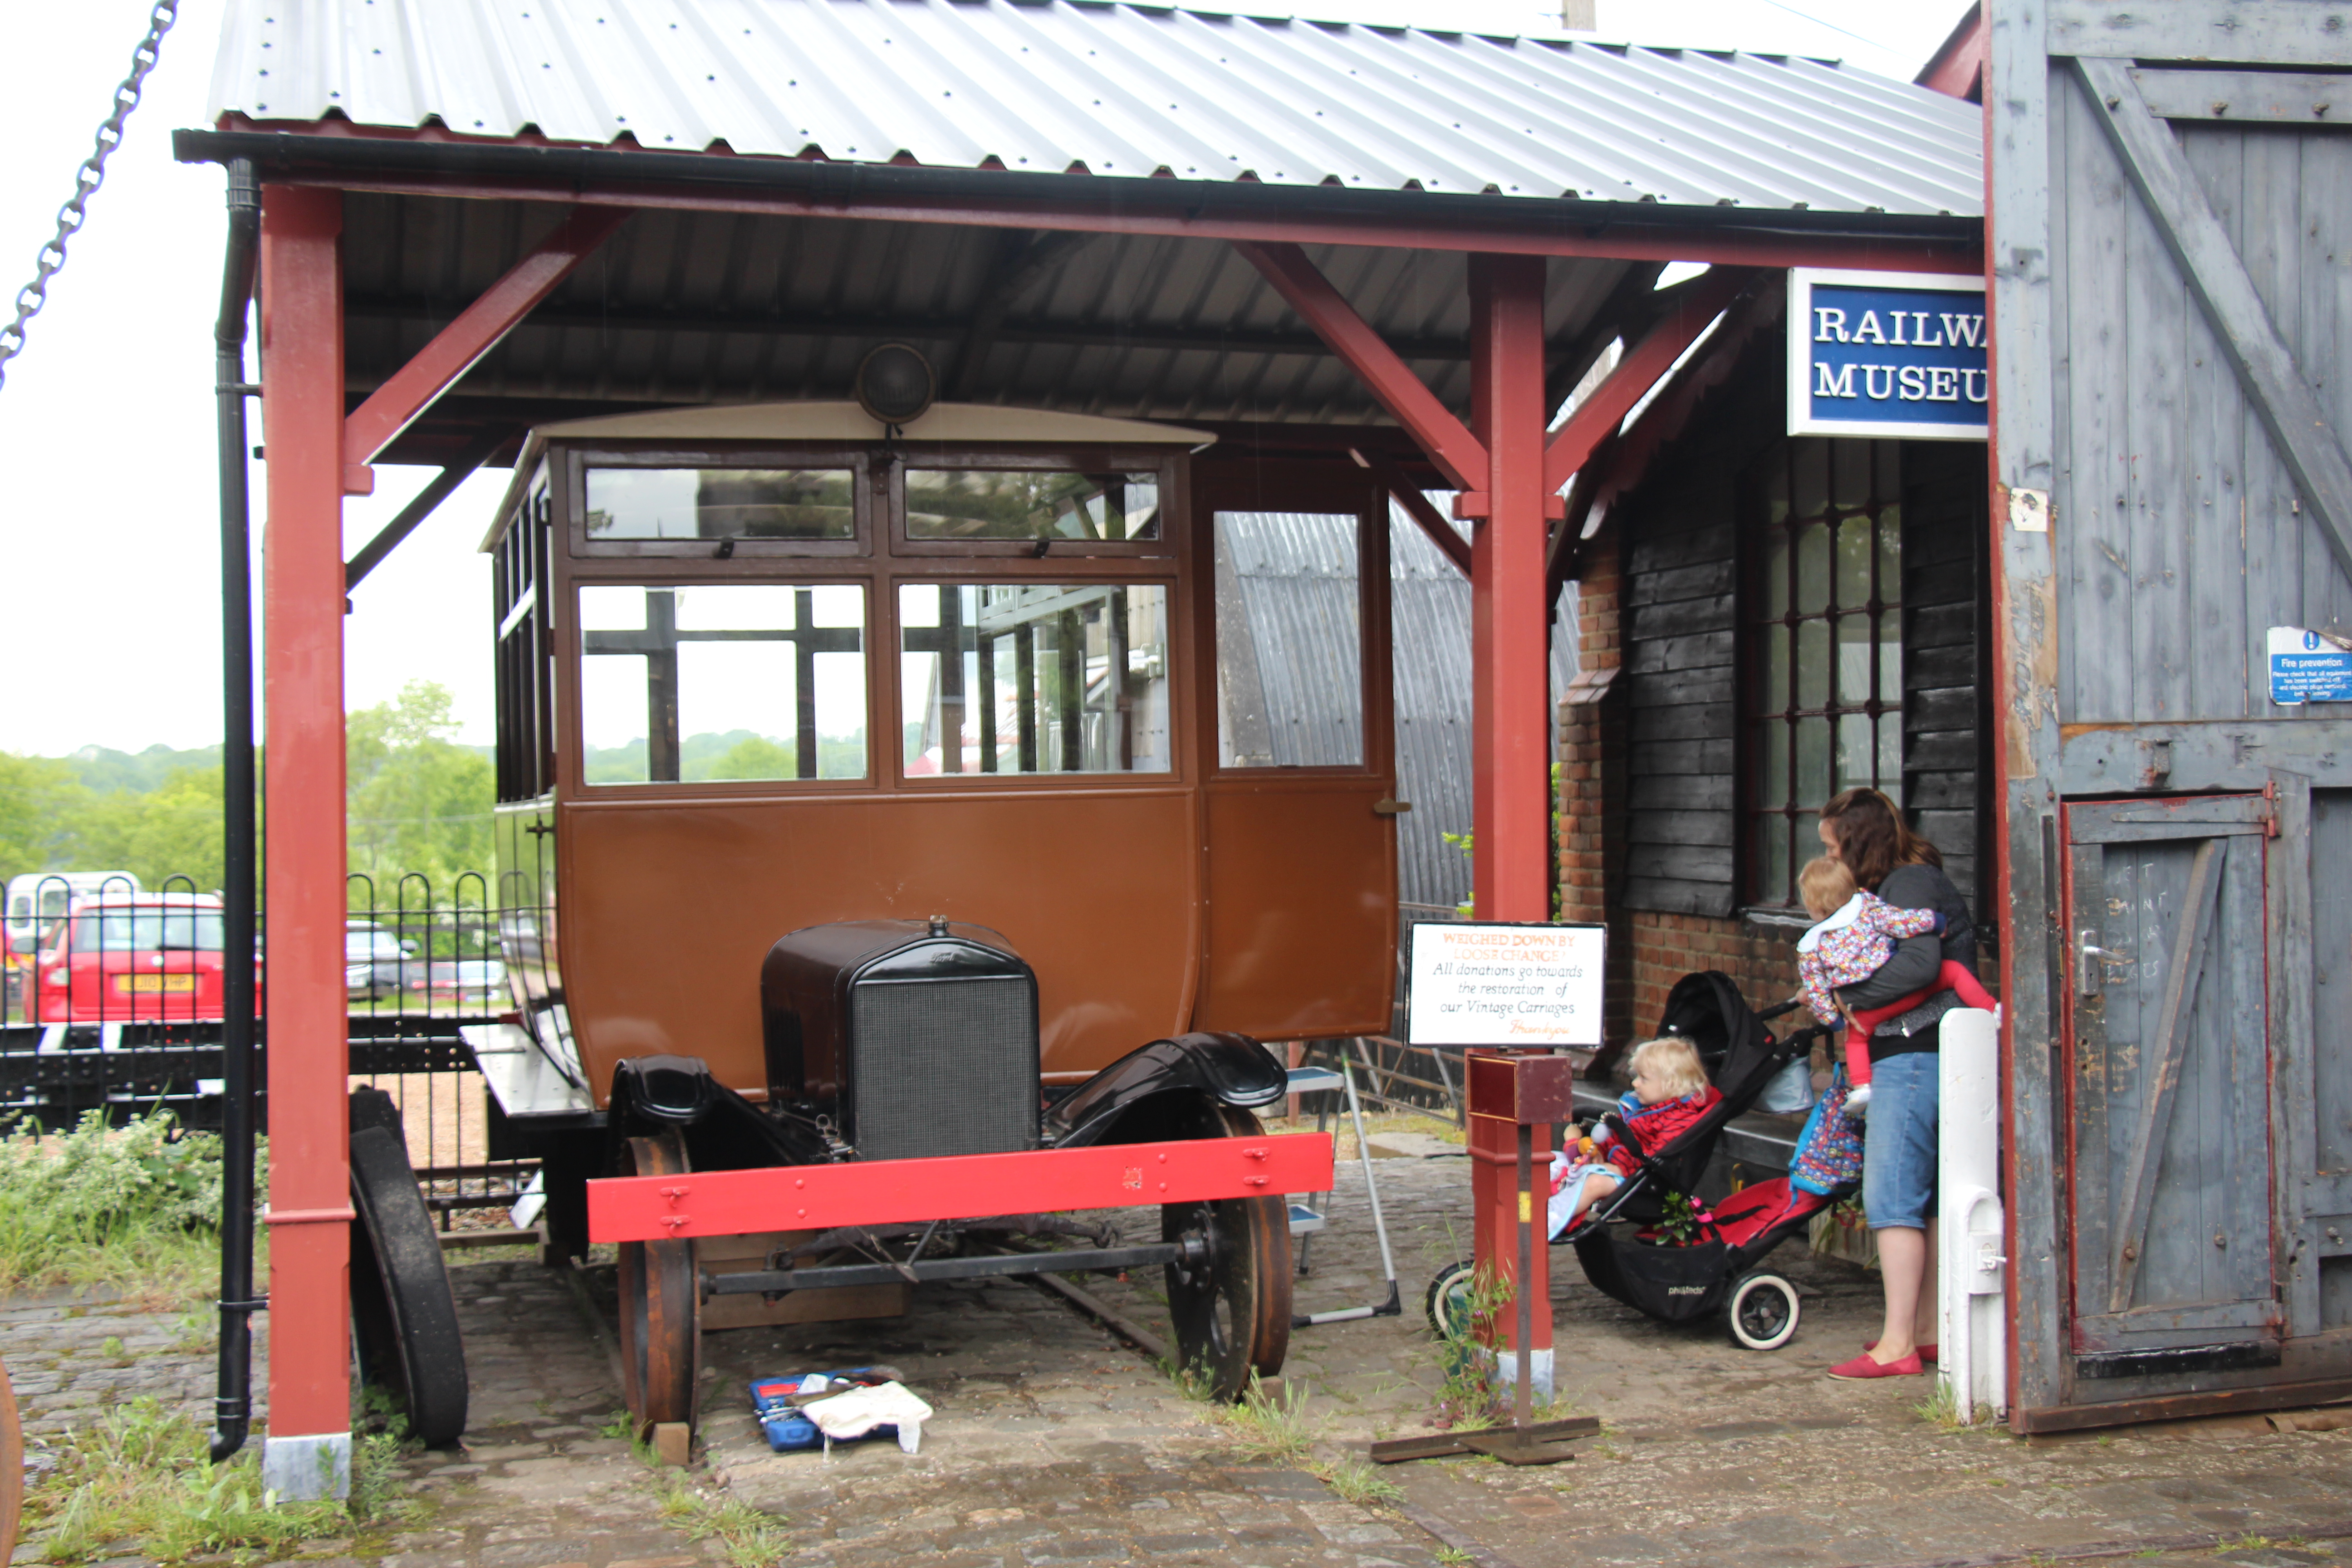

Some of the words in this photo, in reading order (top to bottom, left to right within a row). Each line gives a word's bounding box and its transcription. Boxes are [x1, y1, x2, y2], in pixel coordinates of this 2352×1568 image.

[1814, 307, 1986, 348] RAILW
[1814, 362, 1987, 402] MUSEU
[2281, 658, 2297, 667] Fire
[2299, 658, 2343, 669] prevention
[1443, 933, 1509, 946] WEIGHED
[1512, 934, 1556, 946] DOWN
[1558, 935, 1576, 947] BY
[1454, 948, 1499, 960] LOOSE
[1501, 950, 1566, 962] CHANGE?
[1433, 962, 1453, 975] All
[1456, 963, 1515, 977] donations
[1518, 968, 1533, 981] go
[1536, 965, 1583, 978] towards
[1458, 981, 1476, 994] the
[1480, 983, 1544, 995] restoration
[1555, 982, 1569, 998] of
[1440, 1003, 1463, 1013] our
[1467, 1000, 1514, 1019] Vintage
[1517, 1000, 1575, 1018] Carriages
